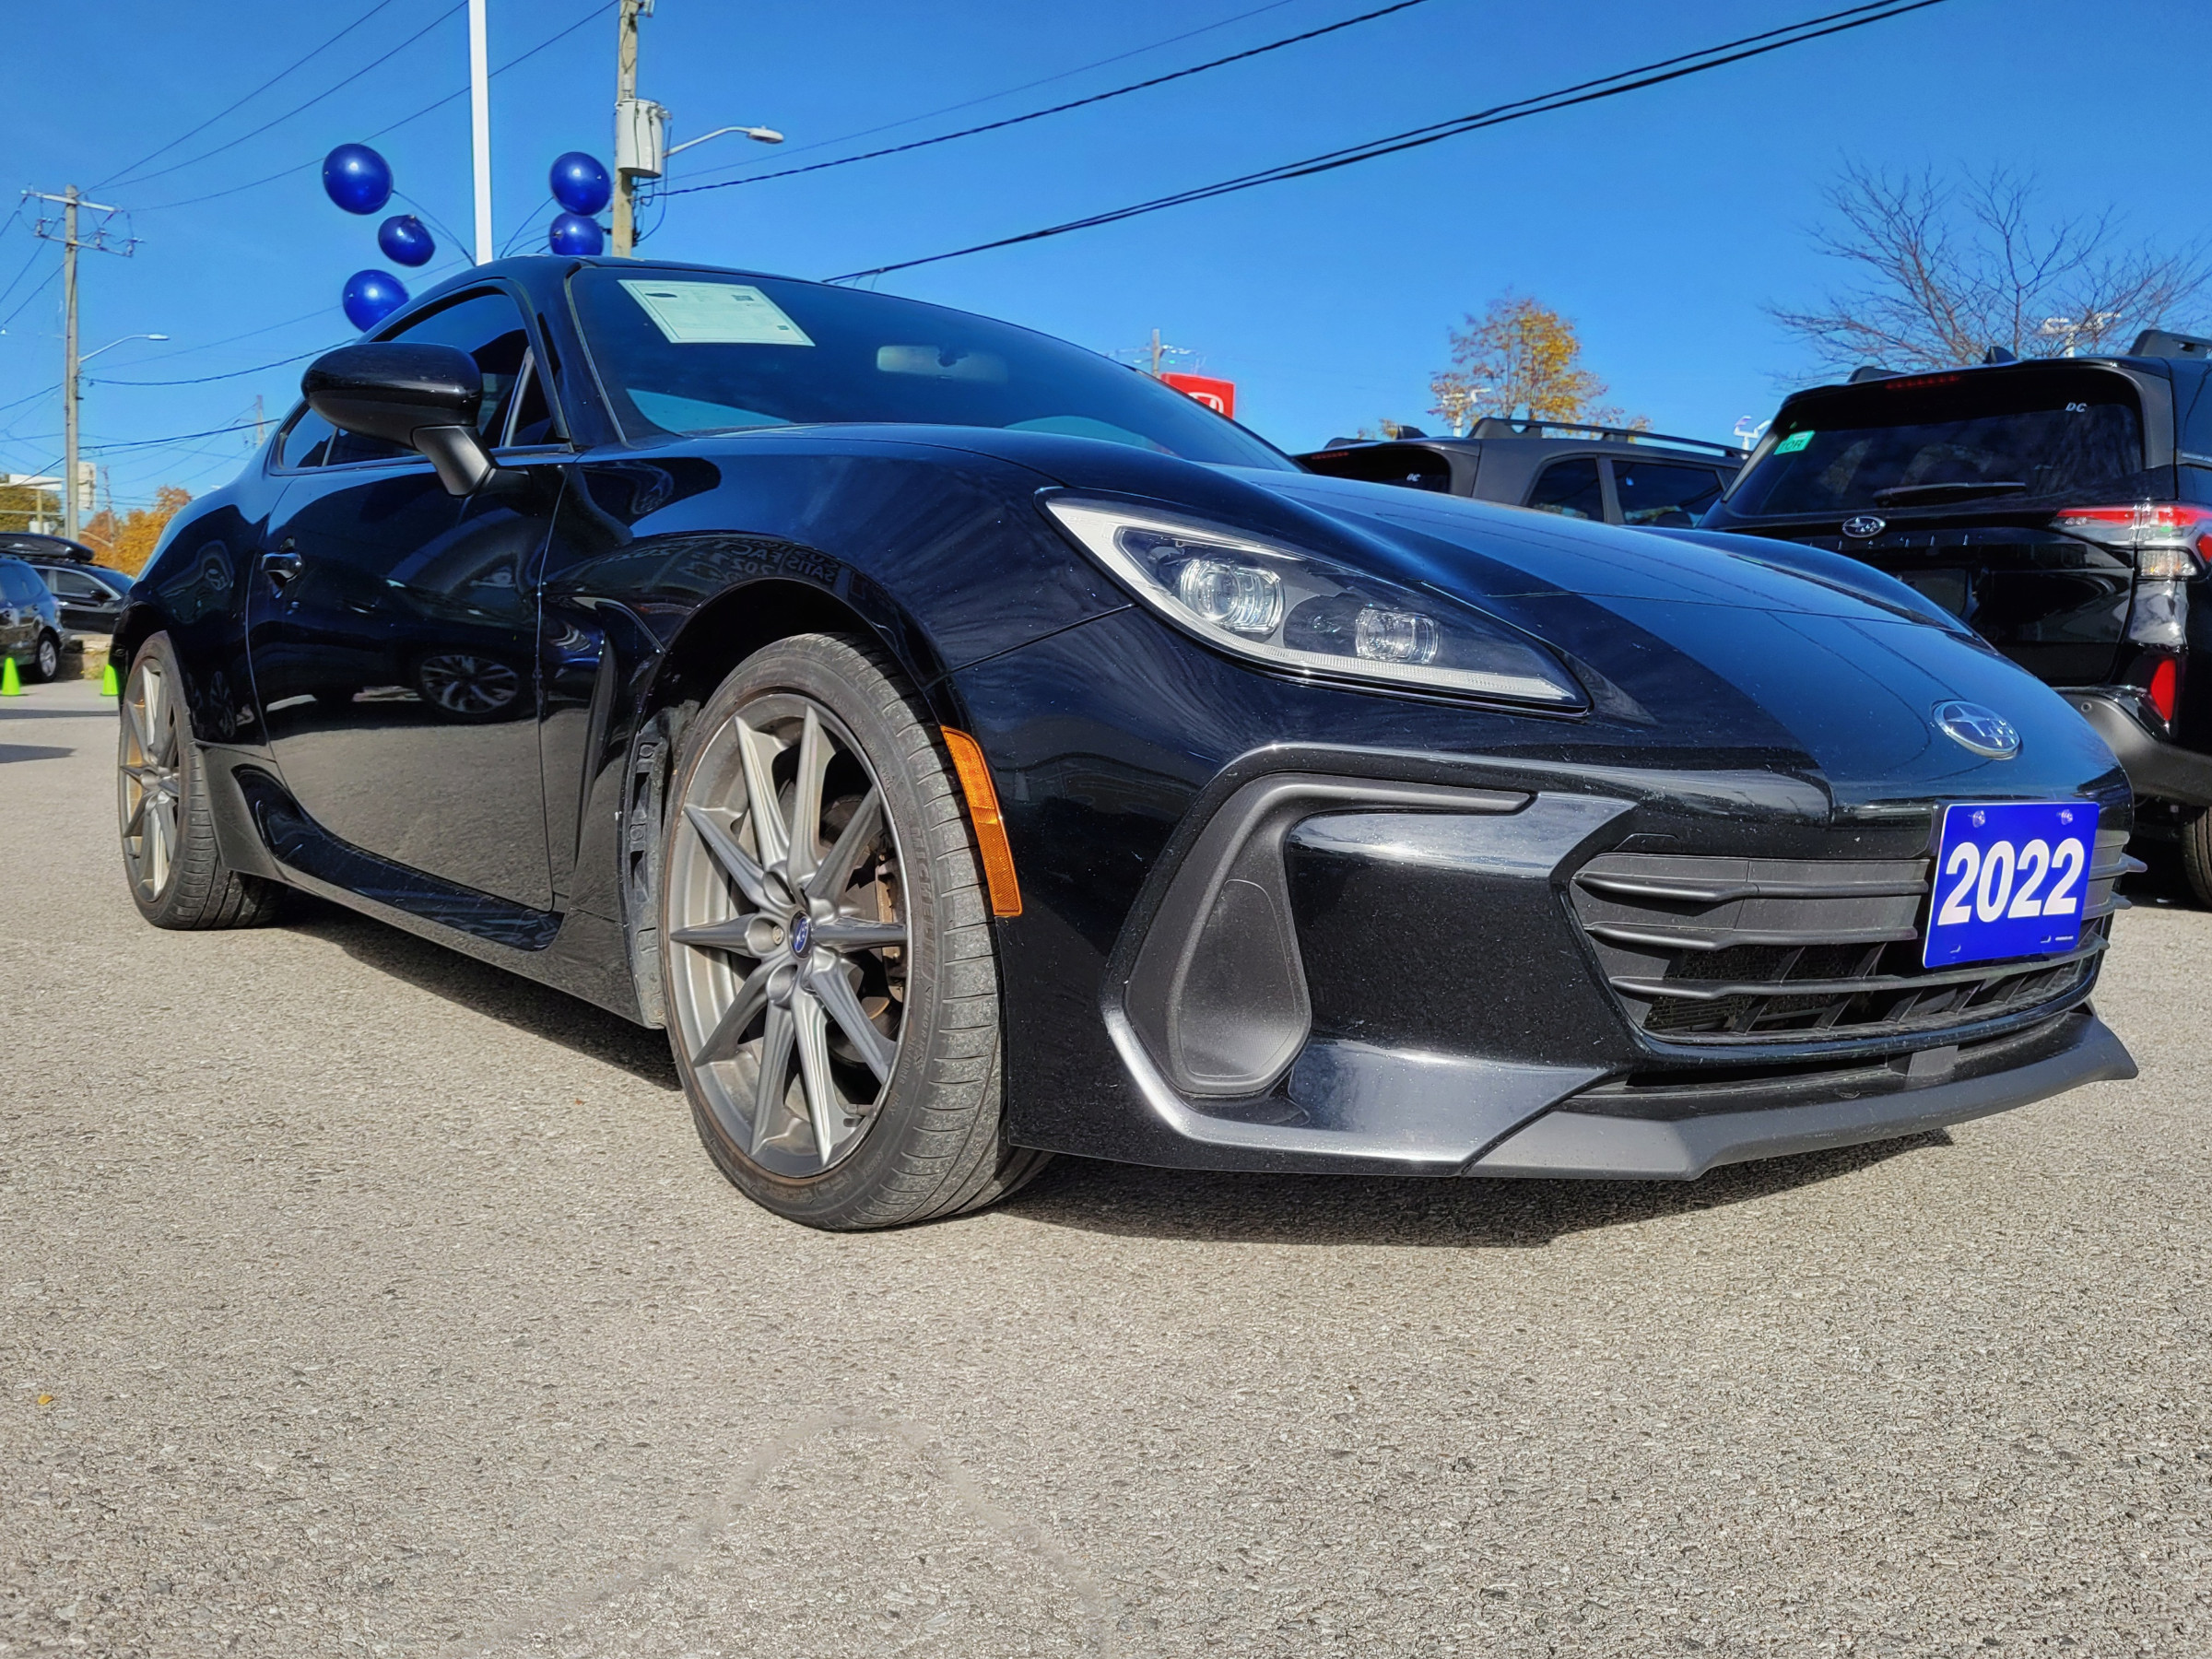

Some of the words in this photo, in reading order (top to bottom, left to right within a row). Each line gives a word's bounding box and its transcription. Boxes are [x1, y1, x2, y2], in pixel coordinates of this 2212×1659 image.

[2065, 402, 2088, 413] DC
[910, 826, 935, 971] MICHELIN
[1937, 838, 2084, 925] 2022
